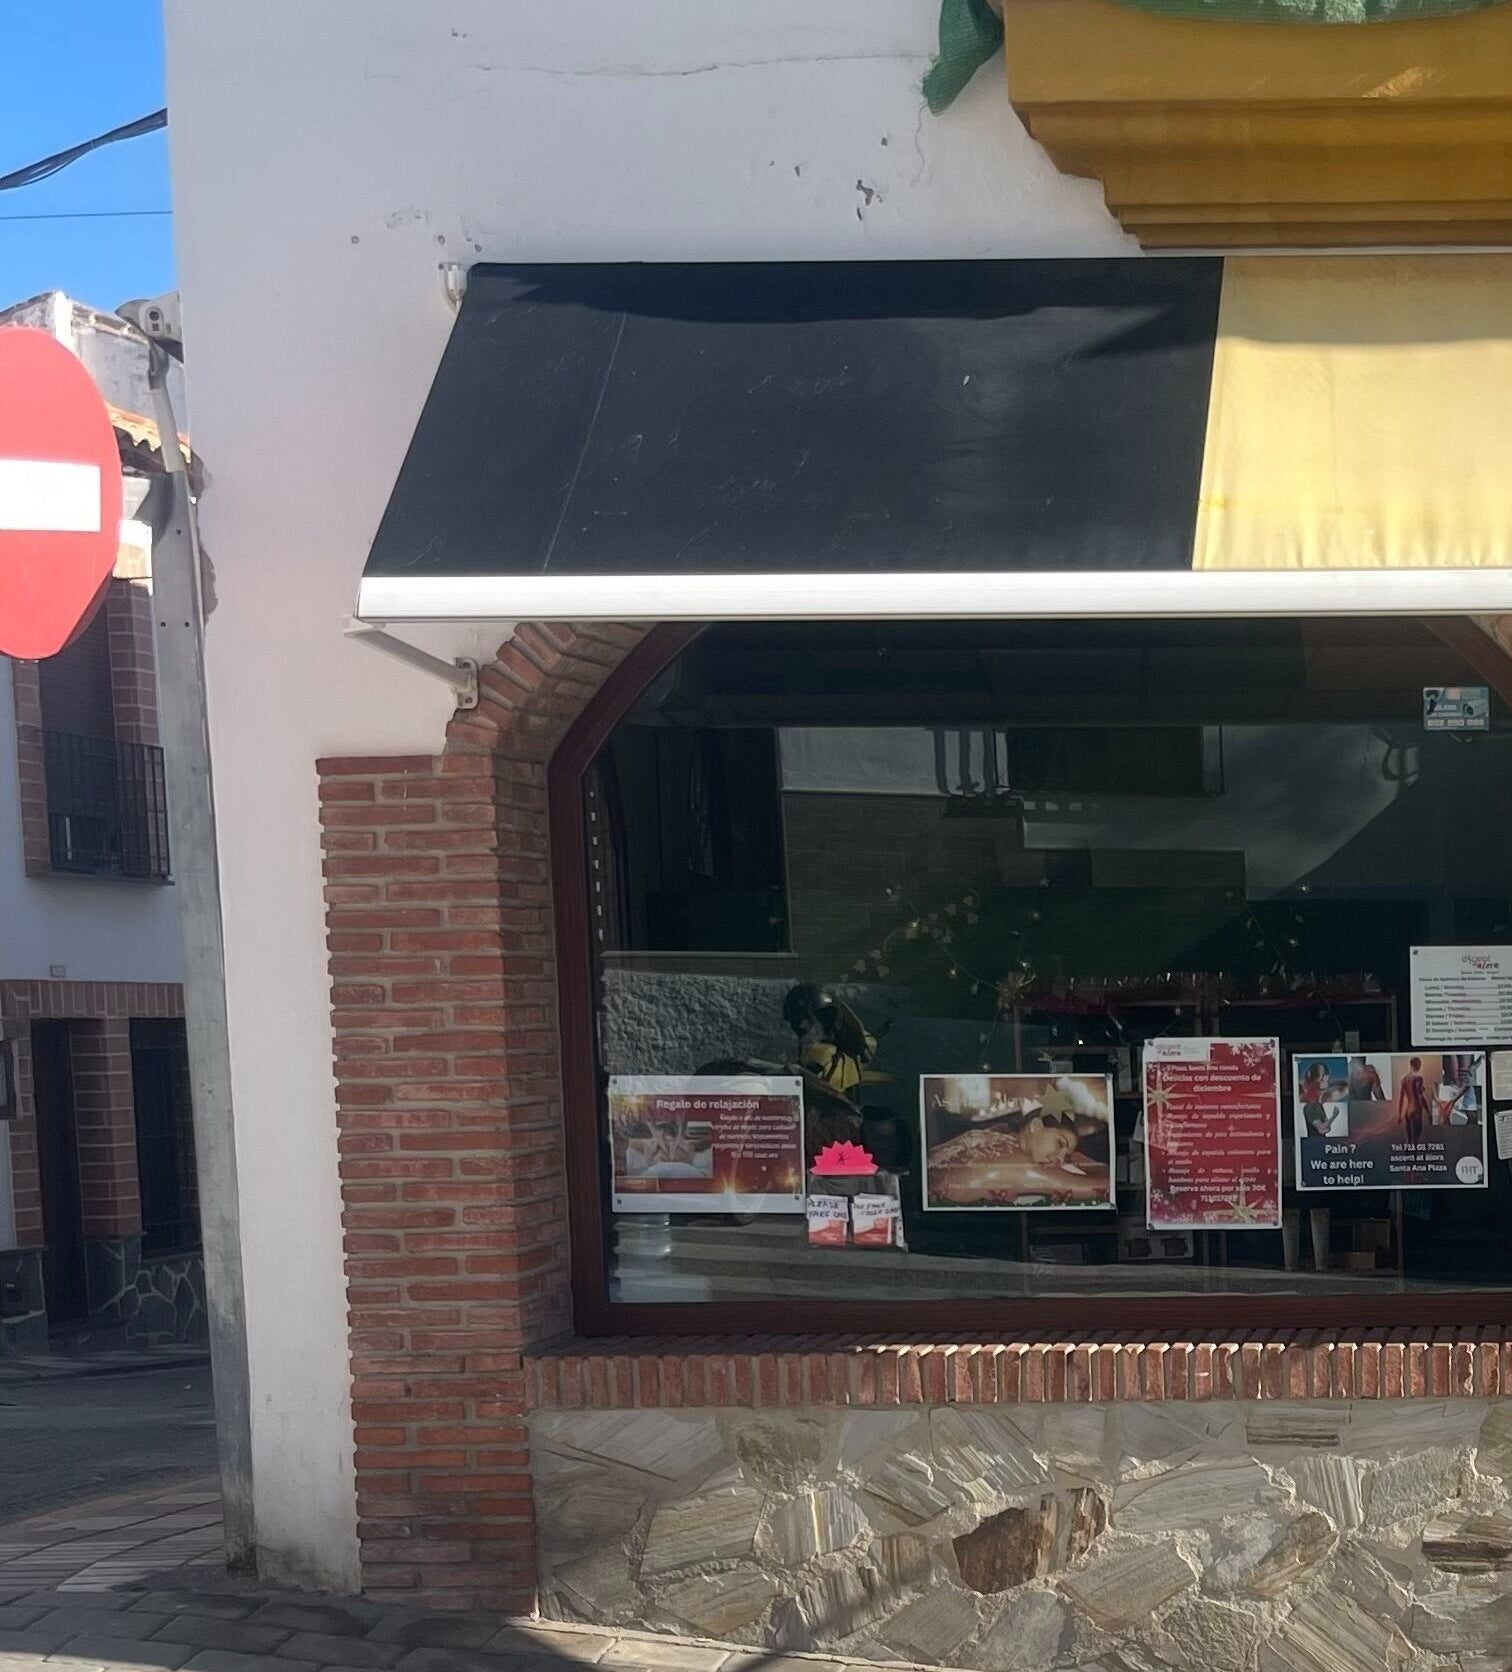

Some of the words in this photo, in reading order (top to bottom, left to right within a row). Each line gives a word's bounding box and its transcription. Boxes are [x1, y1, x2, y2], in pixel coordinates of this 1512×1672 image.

[1210, 1074, 1250, 1082] descuento
[656, 1099, 691, 1111] Regalo
[693, 1099, 707, 1109] de
[708, 1099, 759, 1111] relajación
[1325, 1144, 1349, 1154] Pain
[1310, 1160, 1328, 1169] We
[1329, 1161, 1347, 1169] are
[1349, 1160, 1374, 1169] here
[1323, 1176, 1334, 1185] to
[1337, 1175, 1364, 1186] help!
[808, 1200, 838, 1209] PLEASE
